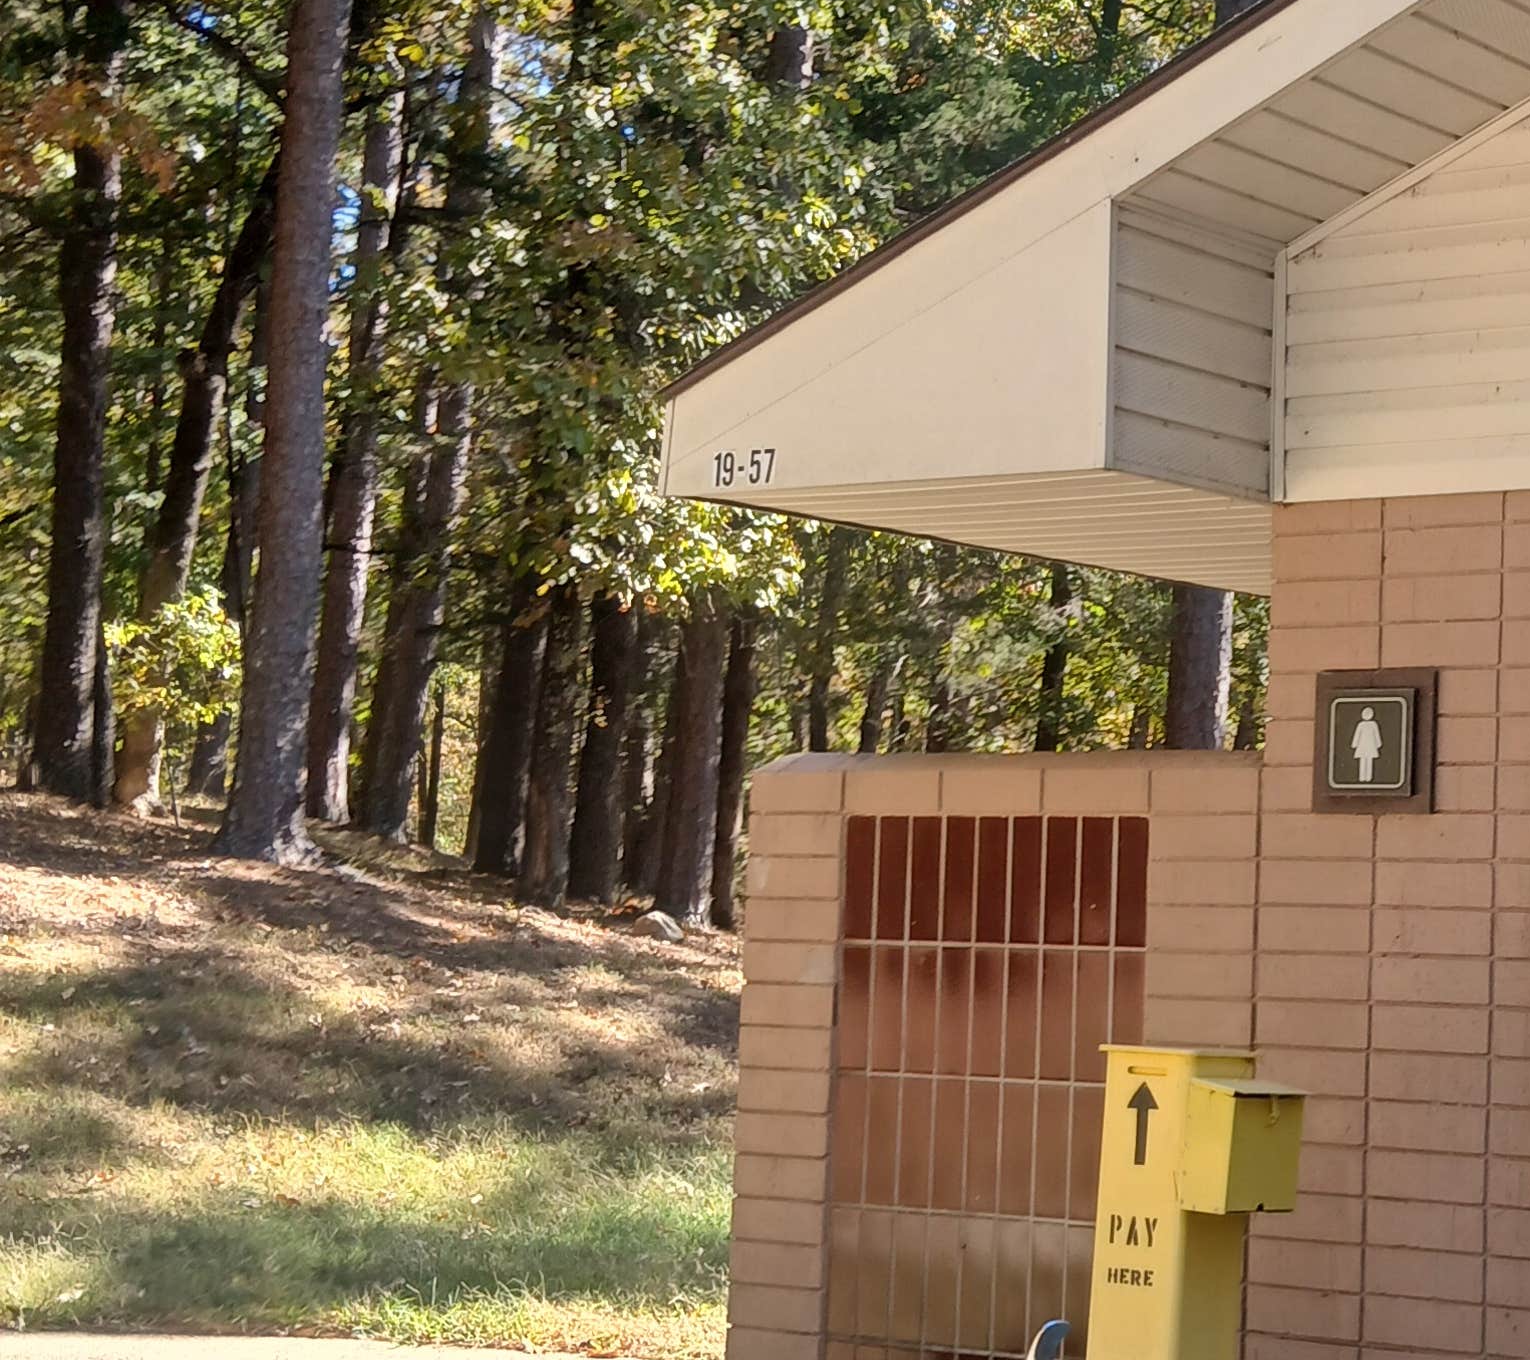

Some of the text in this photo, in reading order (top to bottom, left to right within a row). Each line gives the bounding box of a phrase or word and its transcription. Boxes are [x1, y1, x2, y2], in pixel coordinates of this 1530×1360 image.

[713, 448, 777, 487] 19-57
[1108, 1213, 1158, 1248] PAY
[1107, 1267, 1155, 1287] HERE
